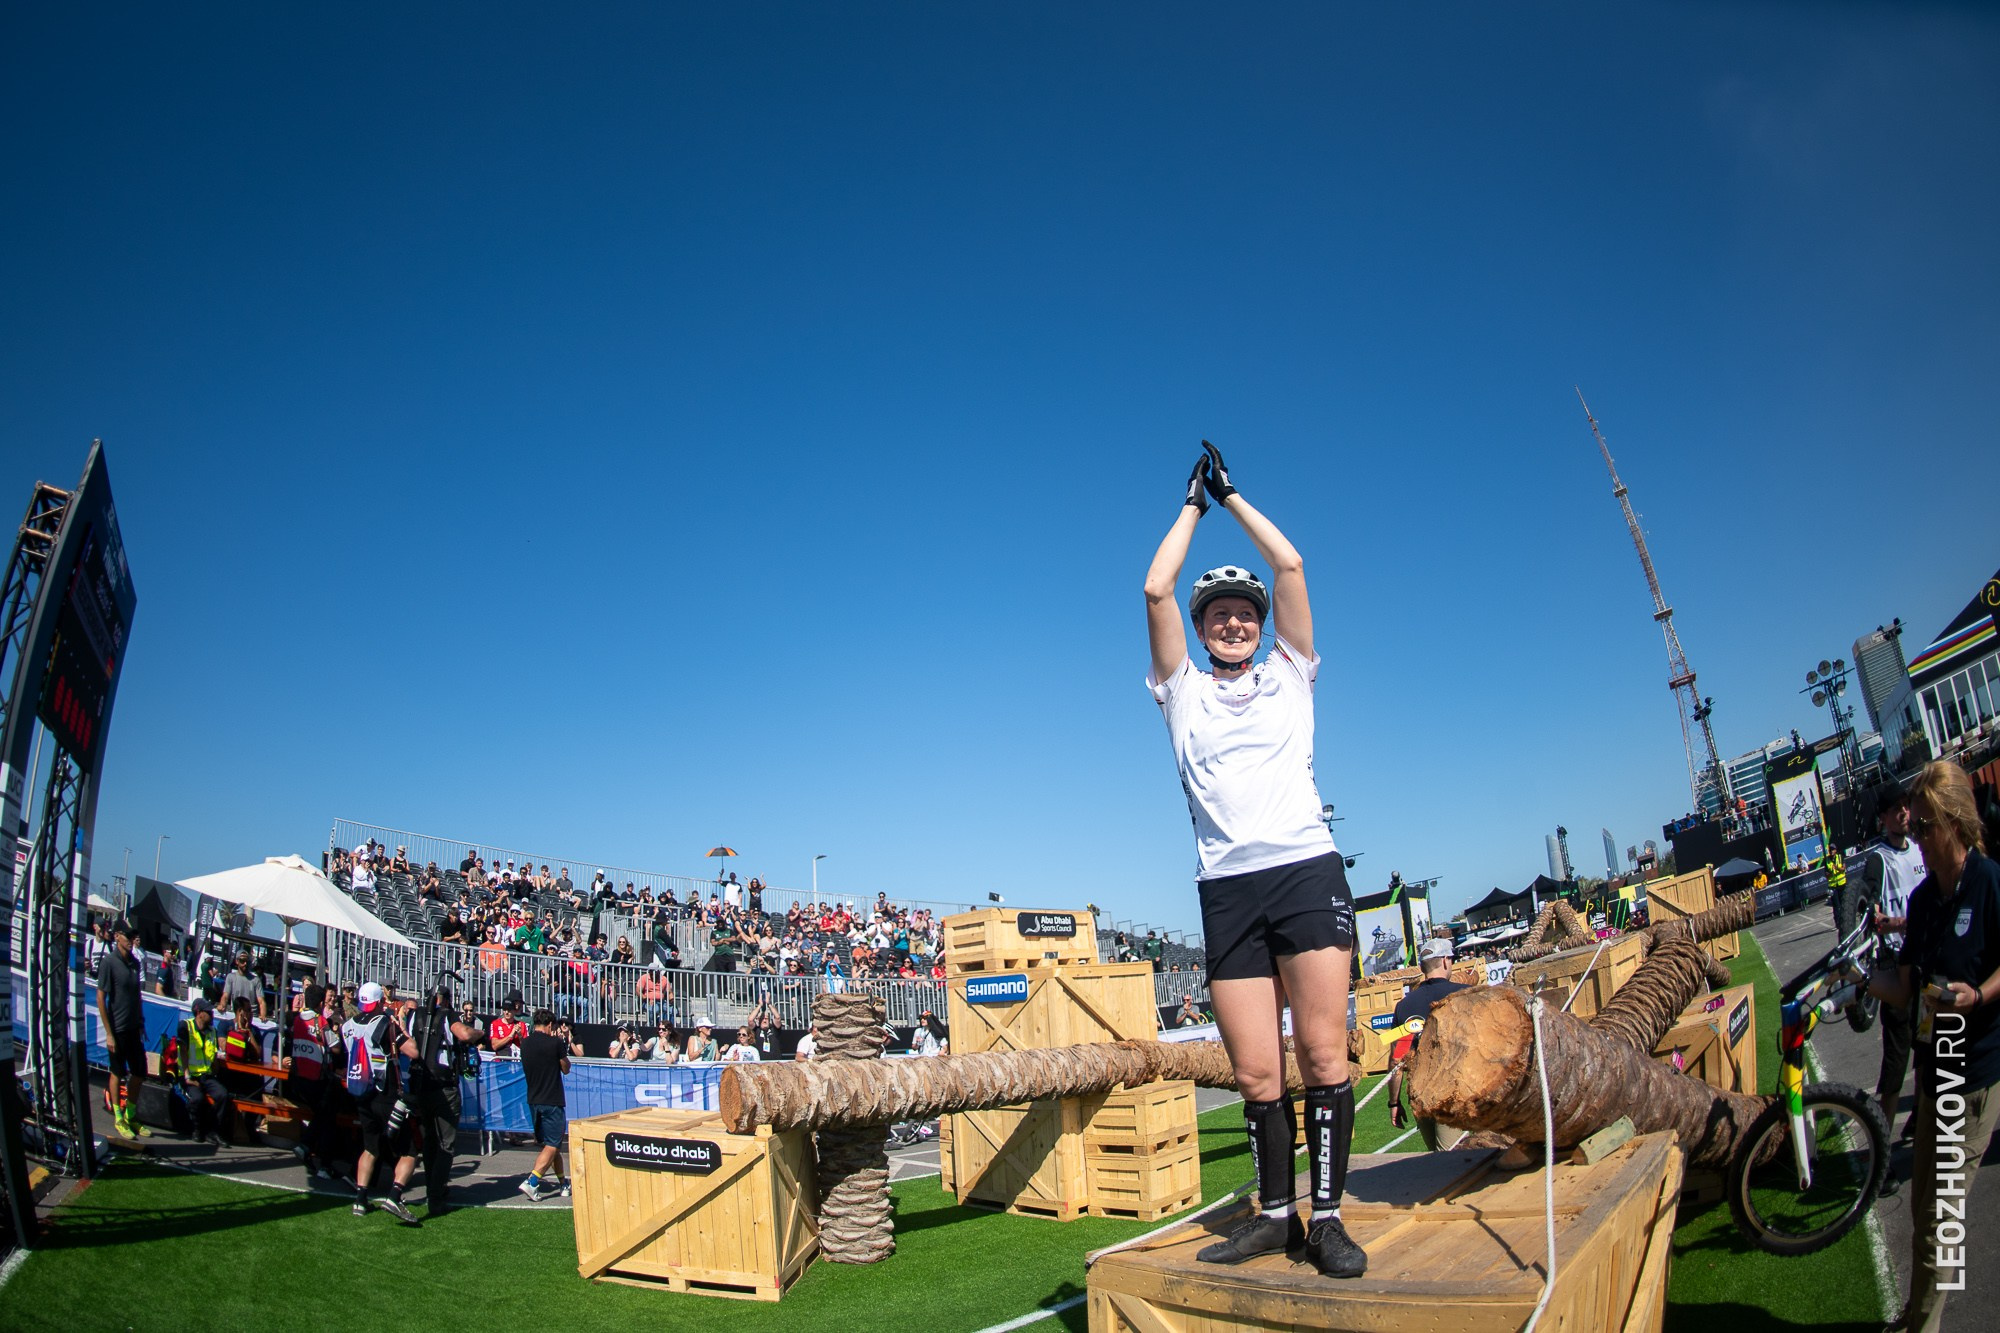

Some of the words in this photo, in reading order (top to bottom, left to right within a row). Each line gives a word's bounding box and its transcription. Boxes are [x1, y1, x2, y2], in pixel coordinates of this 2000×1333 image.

[1041, 915, 1053, 925] Abu
[1053, 916, 1071, 925] Dhabi
[1041, 924, 1055, 933] Sports
[1056, 924, 1072, 932] Council
[1487, 966, 1507, 982] OT
[967, 980, 1026, 997] SHIMANO
[614, 1139, 641, 1154] bike
[642, 1143, 668, 1157] abu
[671, 1145, 710, 1160] dhabi
[1317, 1127, 1331, 1199] hebo
